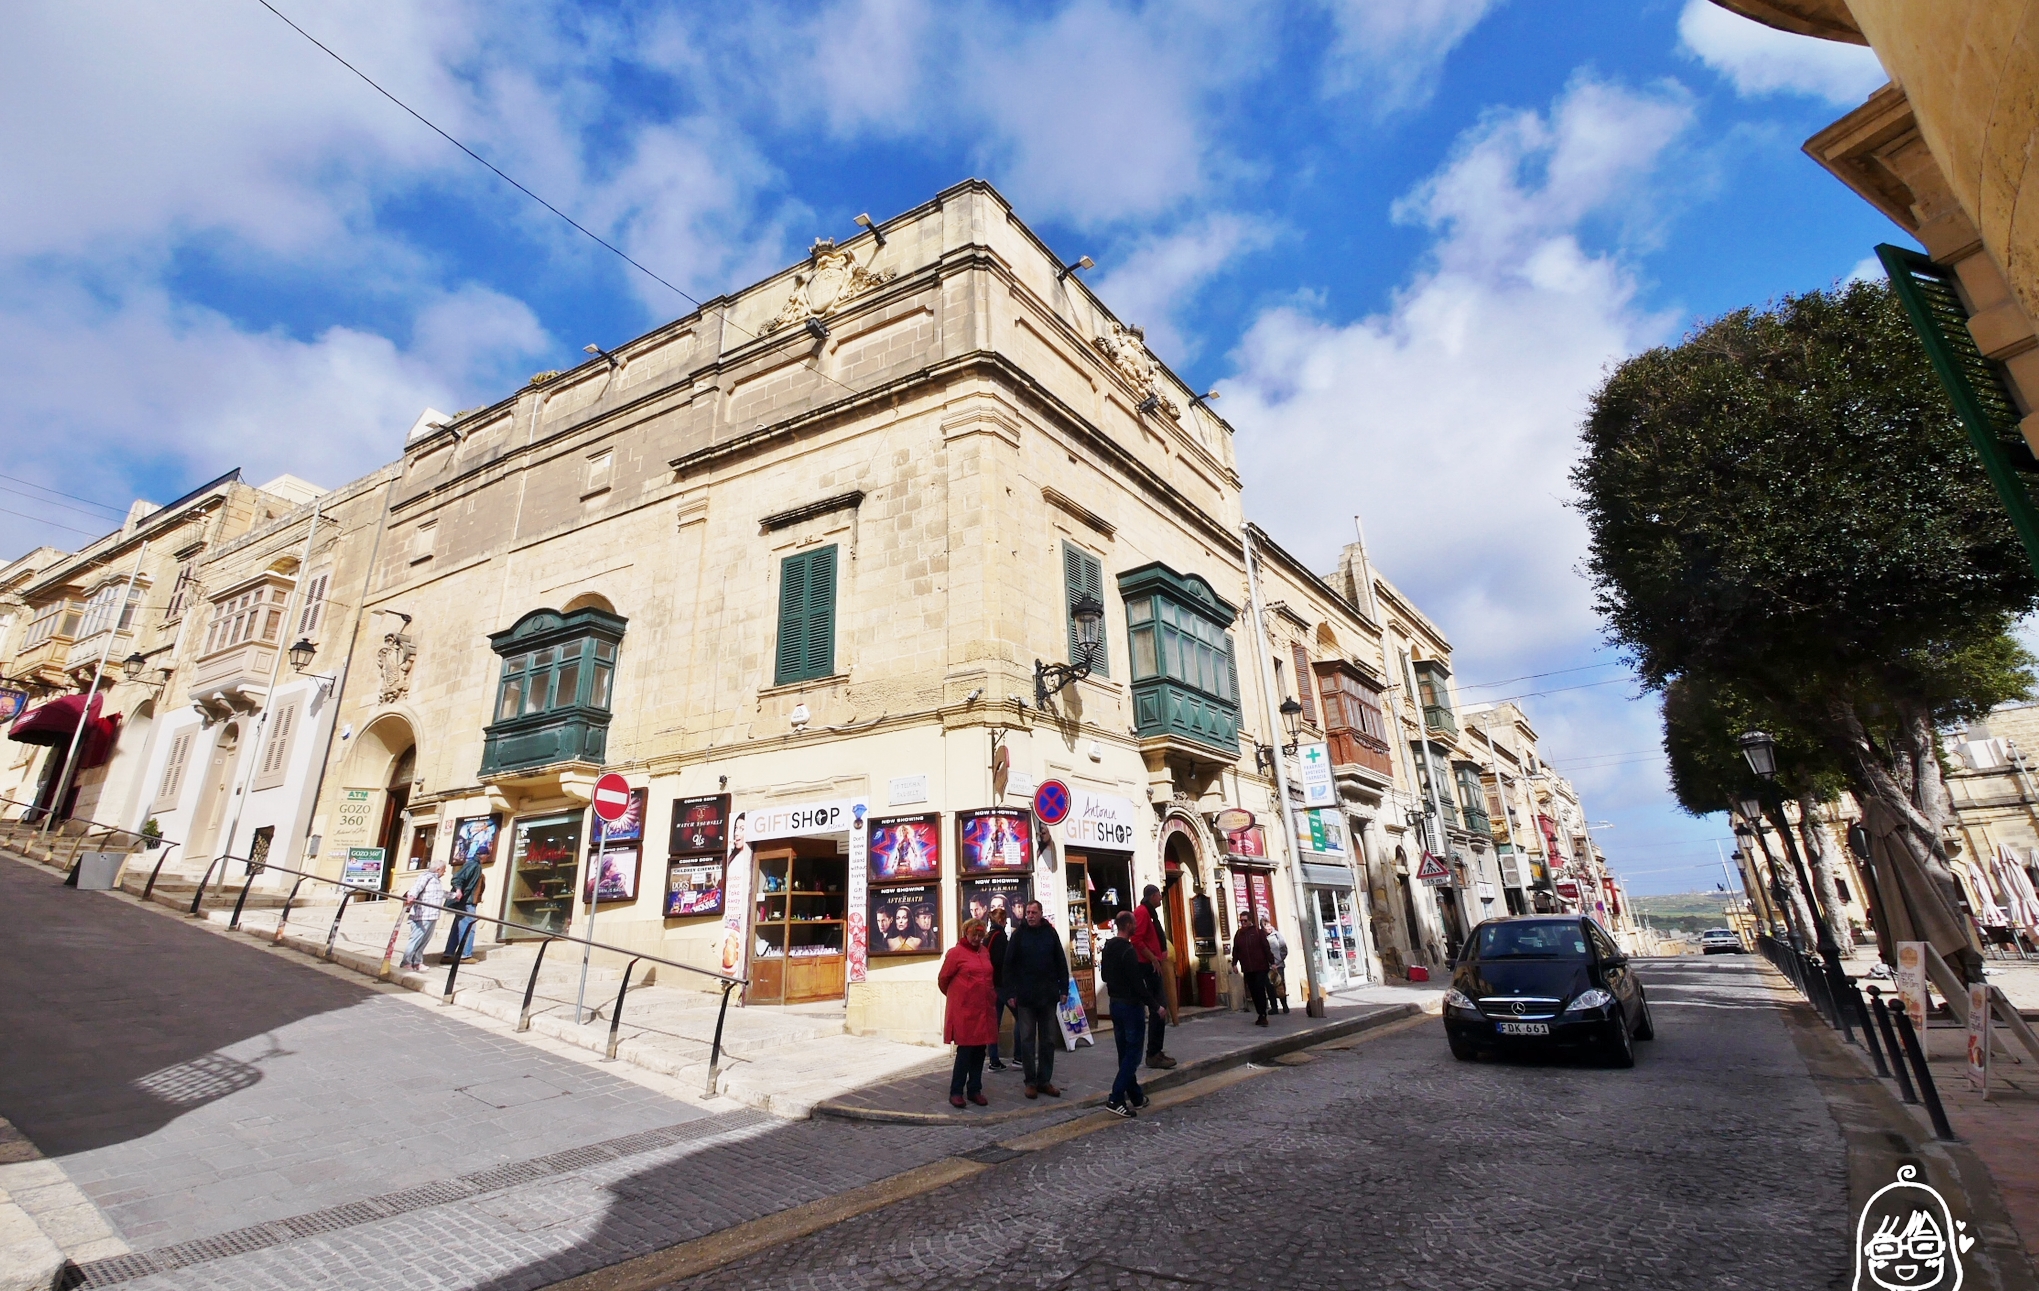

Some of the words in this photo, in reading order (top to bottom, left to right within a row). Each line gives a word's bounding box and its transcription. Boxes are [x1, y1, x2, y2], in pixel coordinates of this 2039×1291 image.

[340, 804, 371, 814] GOZO
[1083, 796, 1117, 820] Antonin
[696, 819, 723, 827] YOURSELF
[887, 896, 923, 904] AFTERMATH
[692, 899, 718, 913] MOVIE
[1501, 1024, 1521, 1033] FDK
[1526, 1025, 1547, 1033] 661
